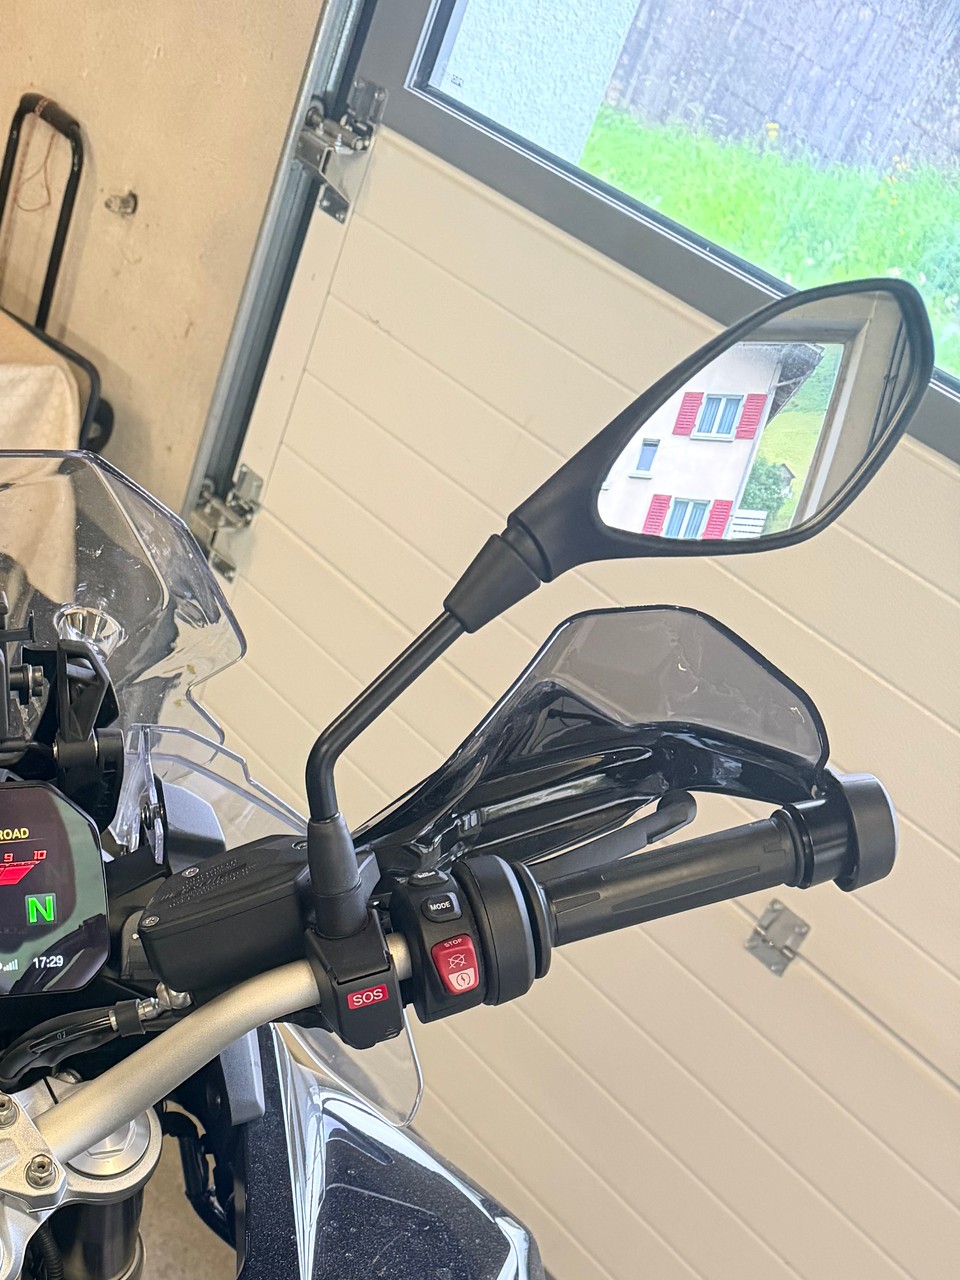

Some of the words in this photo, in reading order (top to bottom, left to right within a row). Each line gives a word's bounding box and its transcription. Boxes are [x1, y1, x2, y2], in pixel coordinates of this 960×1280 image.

[3, 852, 14, 862] 9
[33, 850, 47, 860] 10
[28, 895, 54, 923] N
[429, 900, 451, 911] MODE
[443, 937, 463, 948] STOP
[32, 955, 64, 968] 17:29
[352, 988, 384, 1006] SOS
